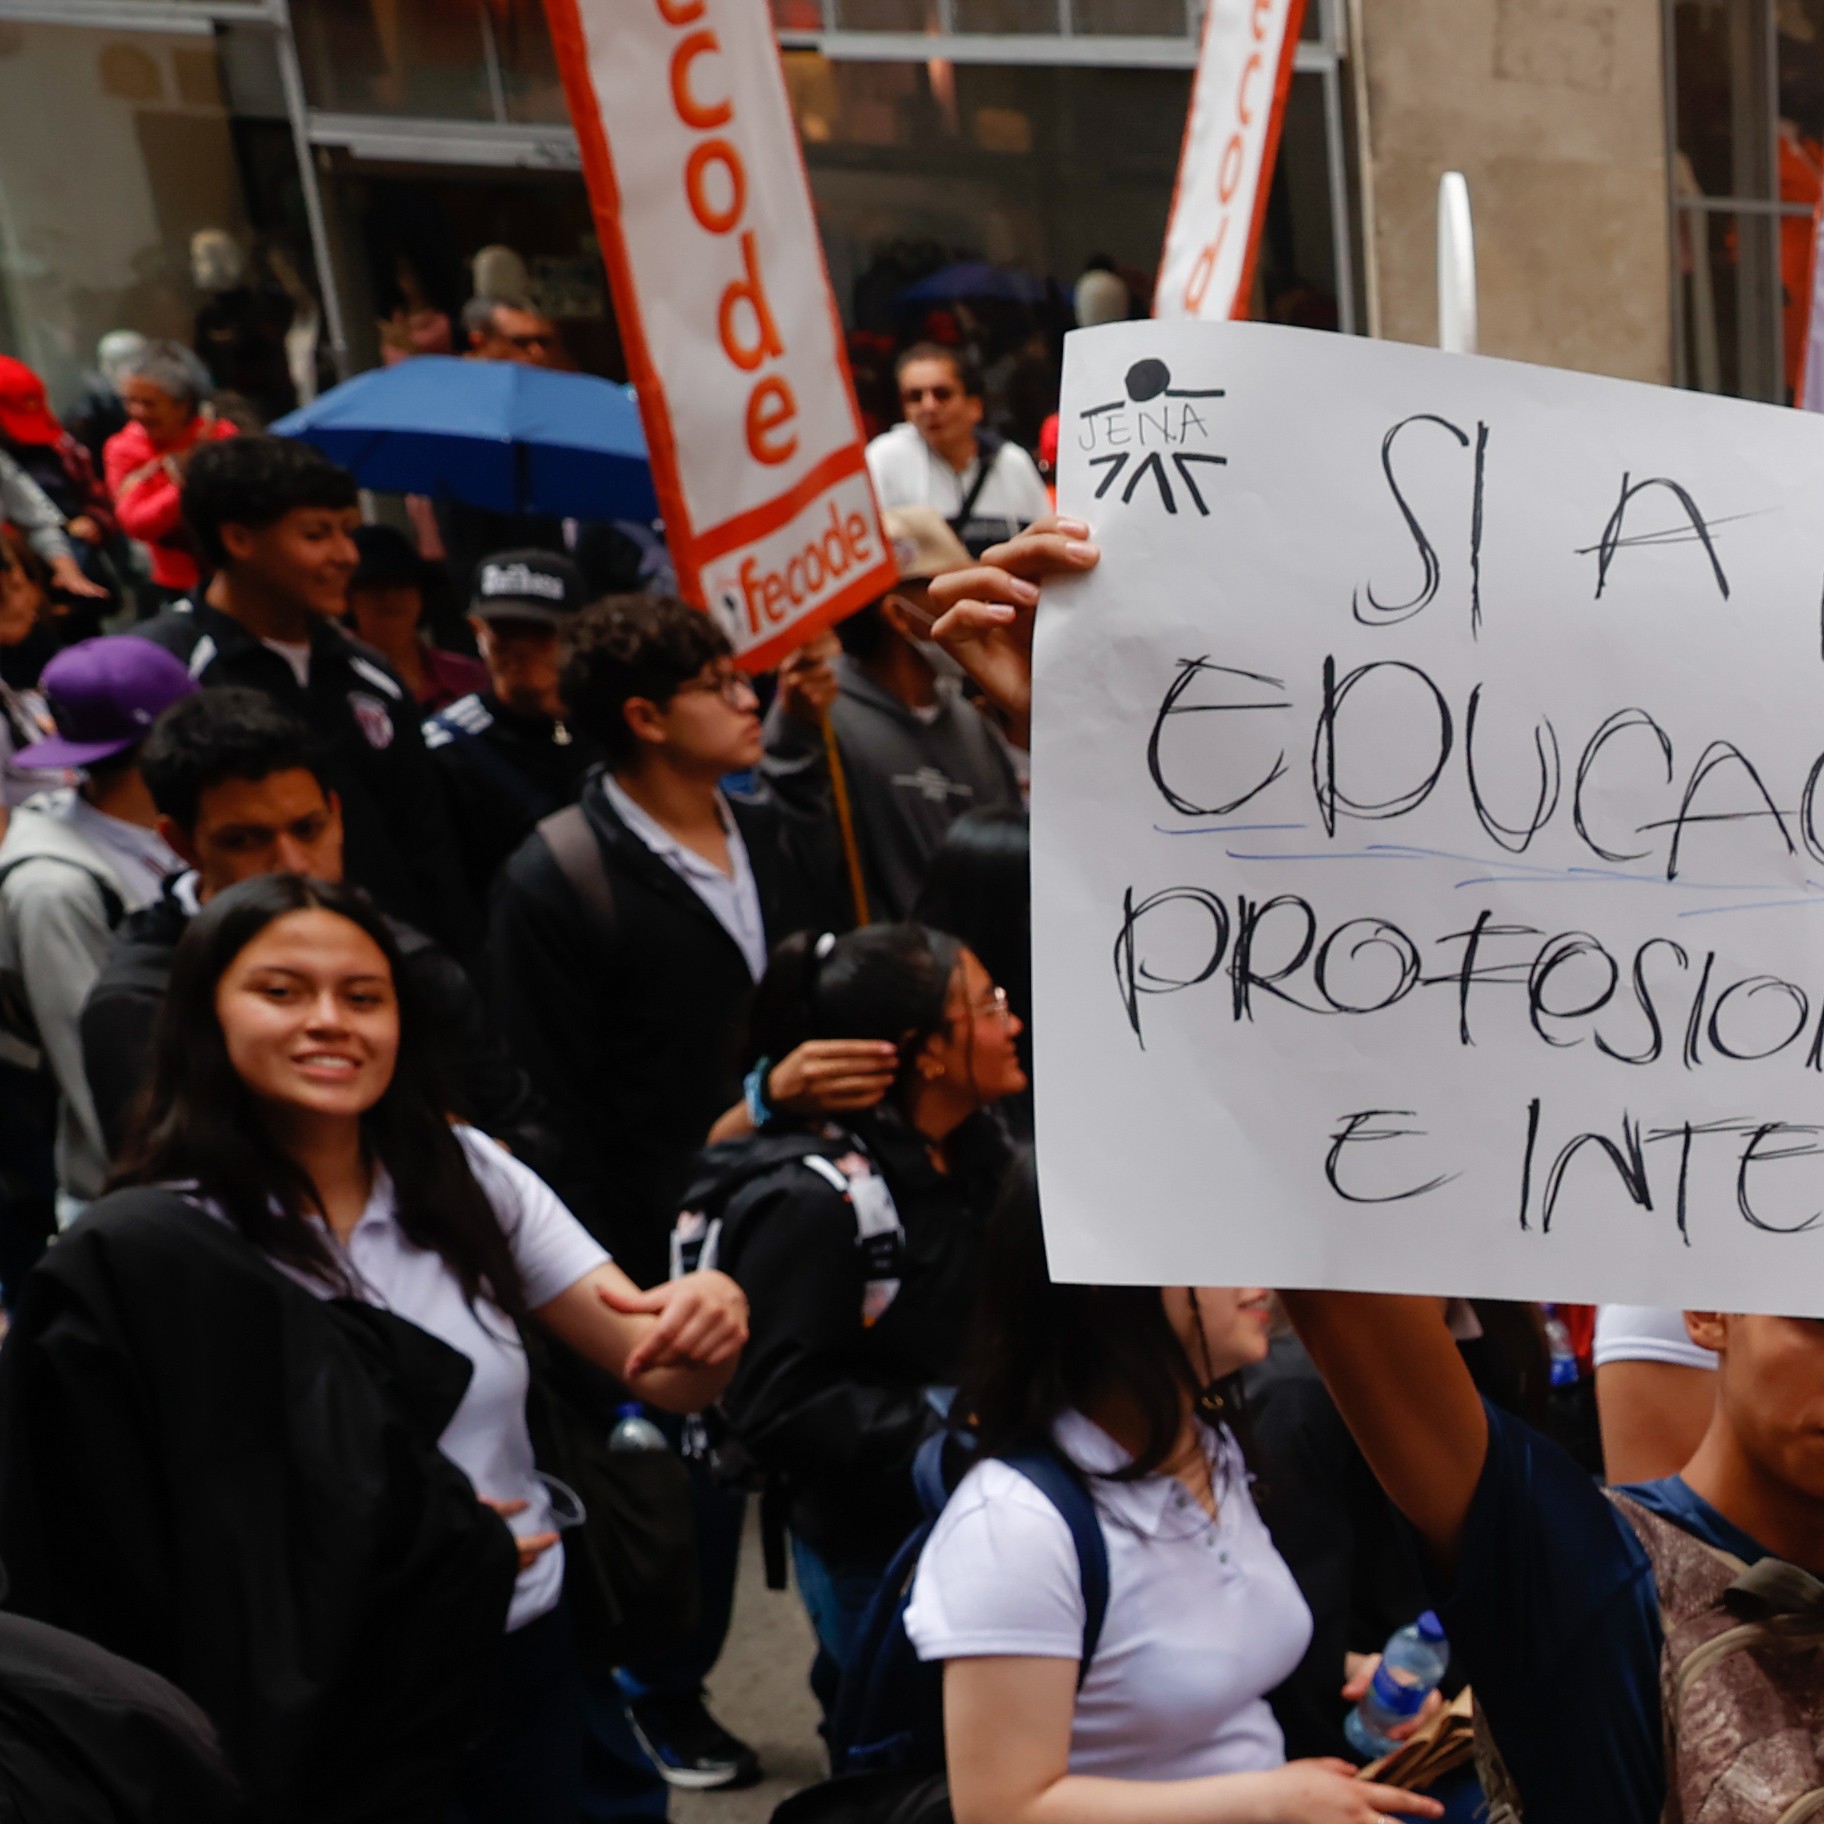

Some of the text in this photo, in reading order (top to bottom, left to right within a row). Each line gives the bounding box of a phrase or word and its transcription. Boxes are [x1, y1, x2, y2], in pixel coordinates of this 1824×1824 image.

[654, 0, 798, 466] code
[737, 502, 871, 636] fecode
[1353, 413, 1490, 642] SI
[1574, 470, 1784, 602] A
[1325, 1109, 1466, 1204] E
